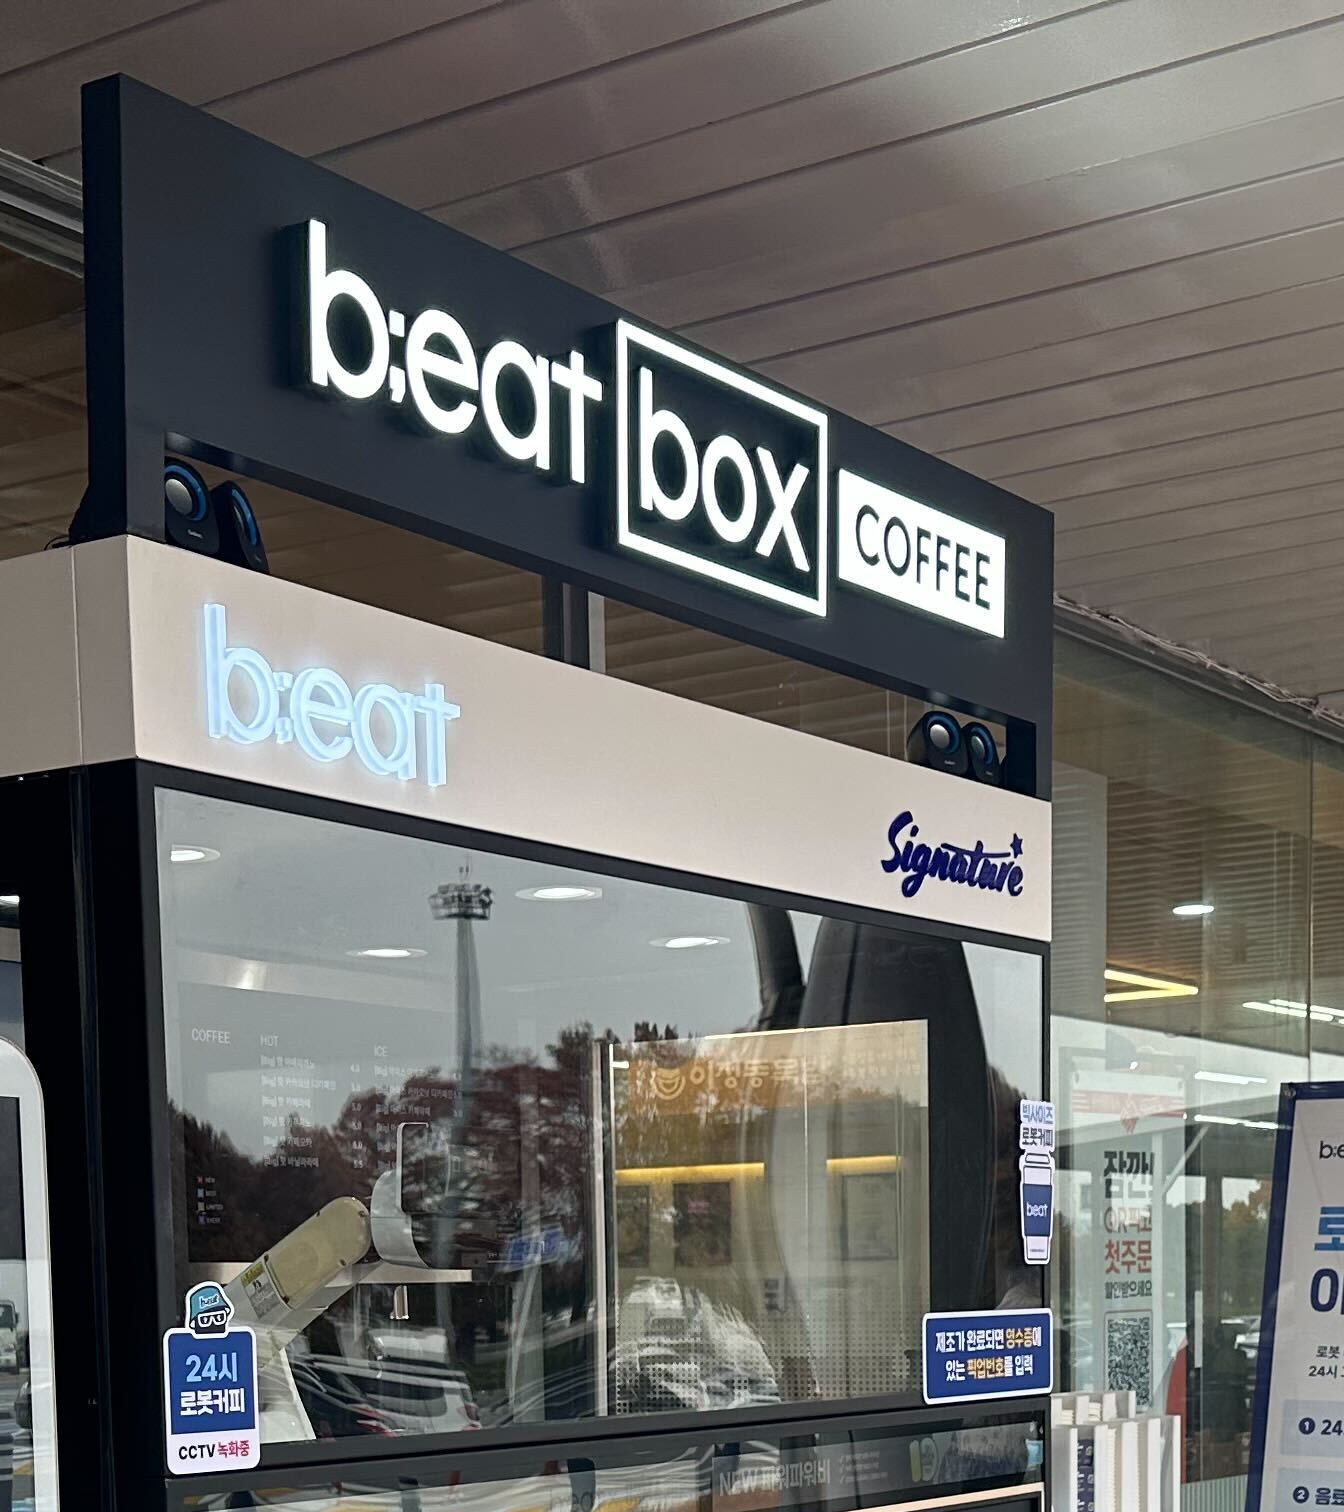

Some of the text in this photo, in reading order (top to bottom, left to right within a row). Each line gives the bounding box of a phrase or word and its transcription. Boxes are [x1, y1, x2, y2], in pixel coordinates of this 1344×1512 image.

[639, 366, 810, 573] box
[855, 503, 992, 610] COFFEE
[880, 810, 1023, 898] Signature
[191, 1028, 231, 1045] COFFEE
[1104, 1239, 1153, 1274] 첫주문
[935, 1326, 1042, 1353] 제조가 완료되면 영수증에
[1316, 1345, 1340, 1359] 로봇
[185, 1352, 239, 1383] 24시
[945, 1354, 1034, 1382] 있는 픽업번호를 입력
[1308, 1365, 1338, 1378] 24시
[180, 1387, 246, 1416] 로봇커피
[178, 1440, 250, 1460] CCTV 녹화중
